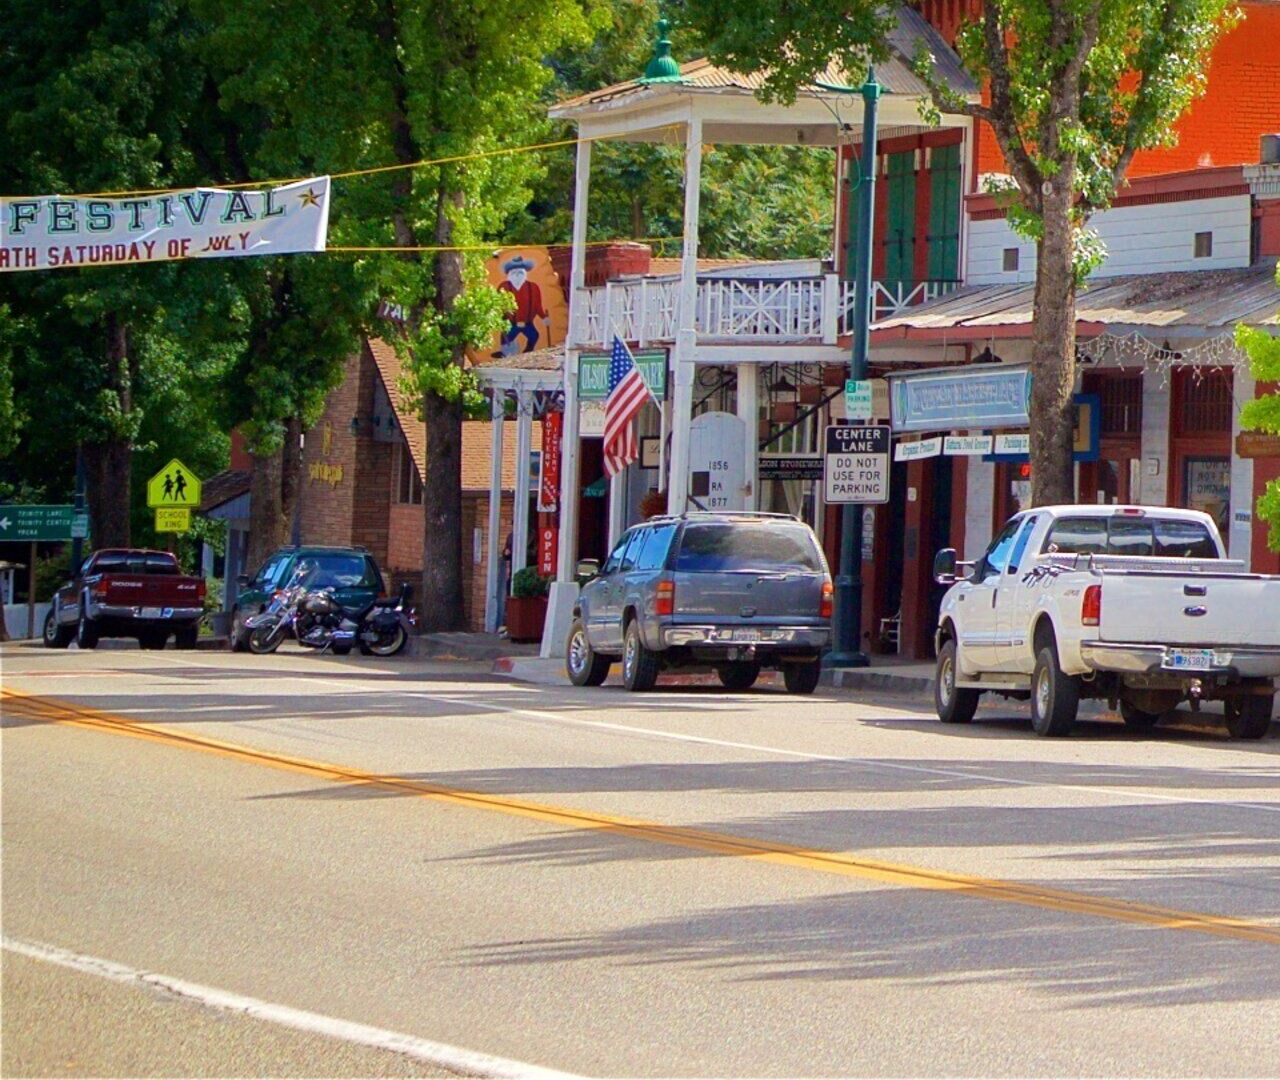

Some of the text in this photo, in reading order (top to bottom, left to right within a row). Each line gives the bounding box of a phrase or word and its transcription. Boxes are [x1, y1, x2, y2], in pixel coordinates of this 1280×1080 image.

[9, 190, 287, 234] FESTIVAL
[48, 240, 156, 266] SATURDAY
[168, 238, 192, 257] OF
[201, 231, 251, 252] JULY
[835, 428, 881, 439] CENTER
[841, 441, 874, 452] LANE
[708, 461, 729, 470] 1856
[836, 457, 877, 468] DO NOT
[833, 471, 854, 481] USE
[859, 471, 880, 481] FOR
[833, 484, 880, 494] PARKING
[708, 498, 728, 507] 1877
[158, 511, 188, 519] SCHOOL
[164, 521, 182, 529] XING
[543, 530, 552, 572] OPEN
